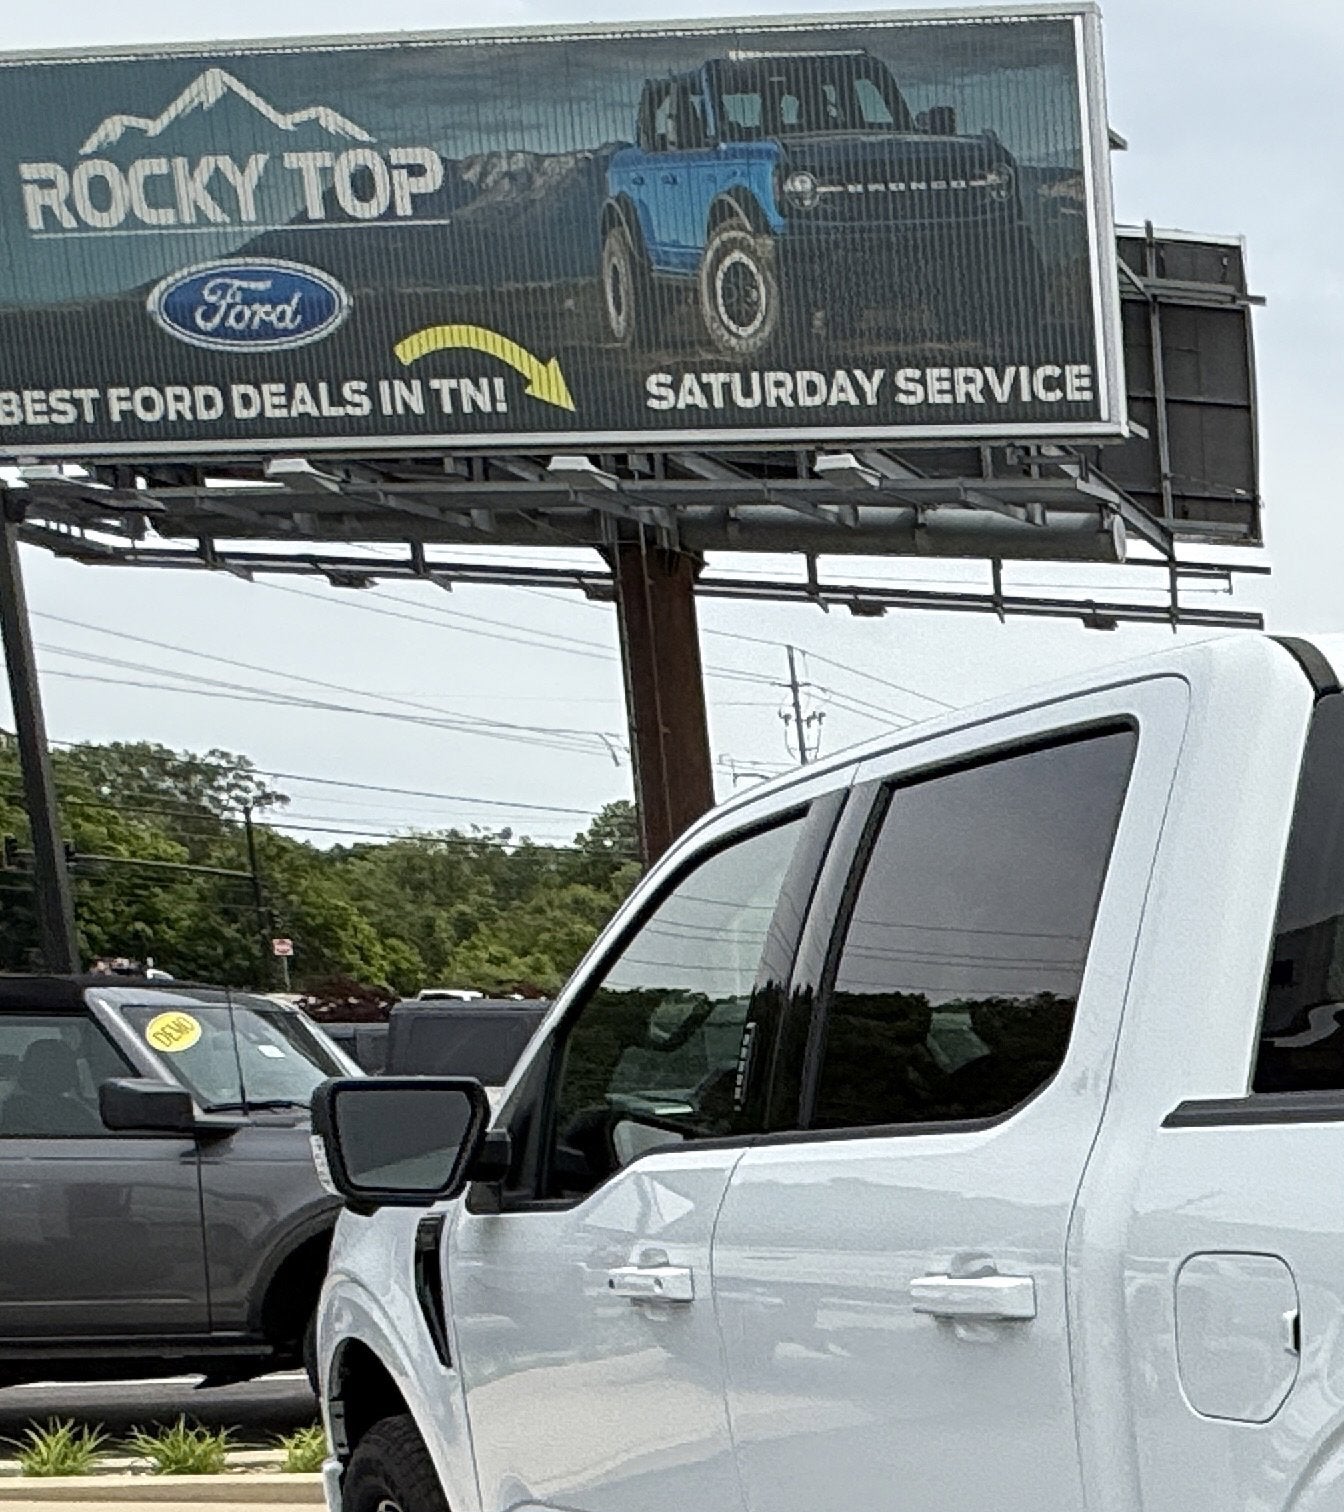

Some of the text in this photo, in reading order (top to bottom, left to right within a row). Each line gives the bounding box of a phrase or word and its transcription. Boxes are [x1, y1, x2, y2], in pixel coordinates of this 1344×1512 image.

[18, 147, 445, 230] ROCKY TOP
[194, 277, 303, 332] Ford
[0, 376, 509, 426] BEST FORD DEALS IN TN!
[646, 364, 1094, 410] SATURDAY SERVICE
[153, 1015, 195, 1048] DEMO
